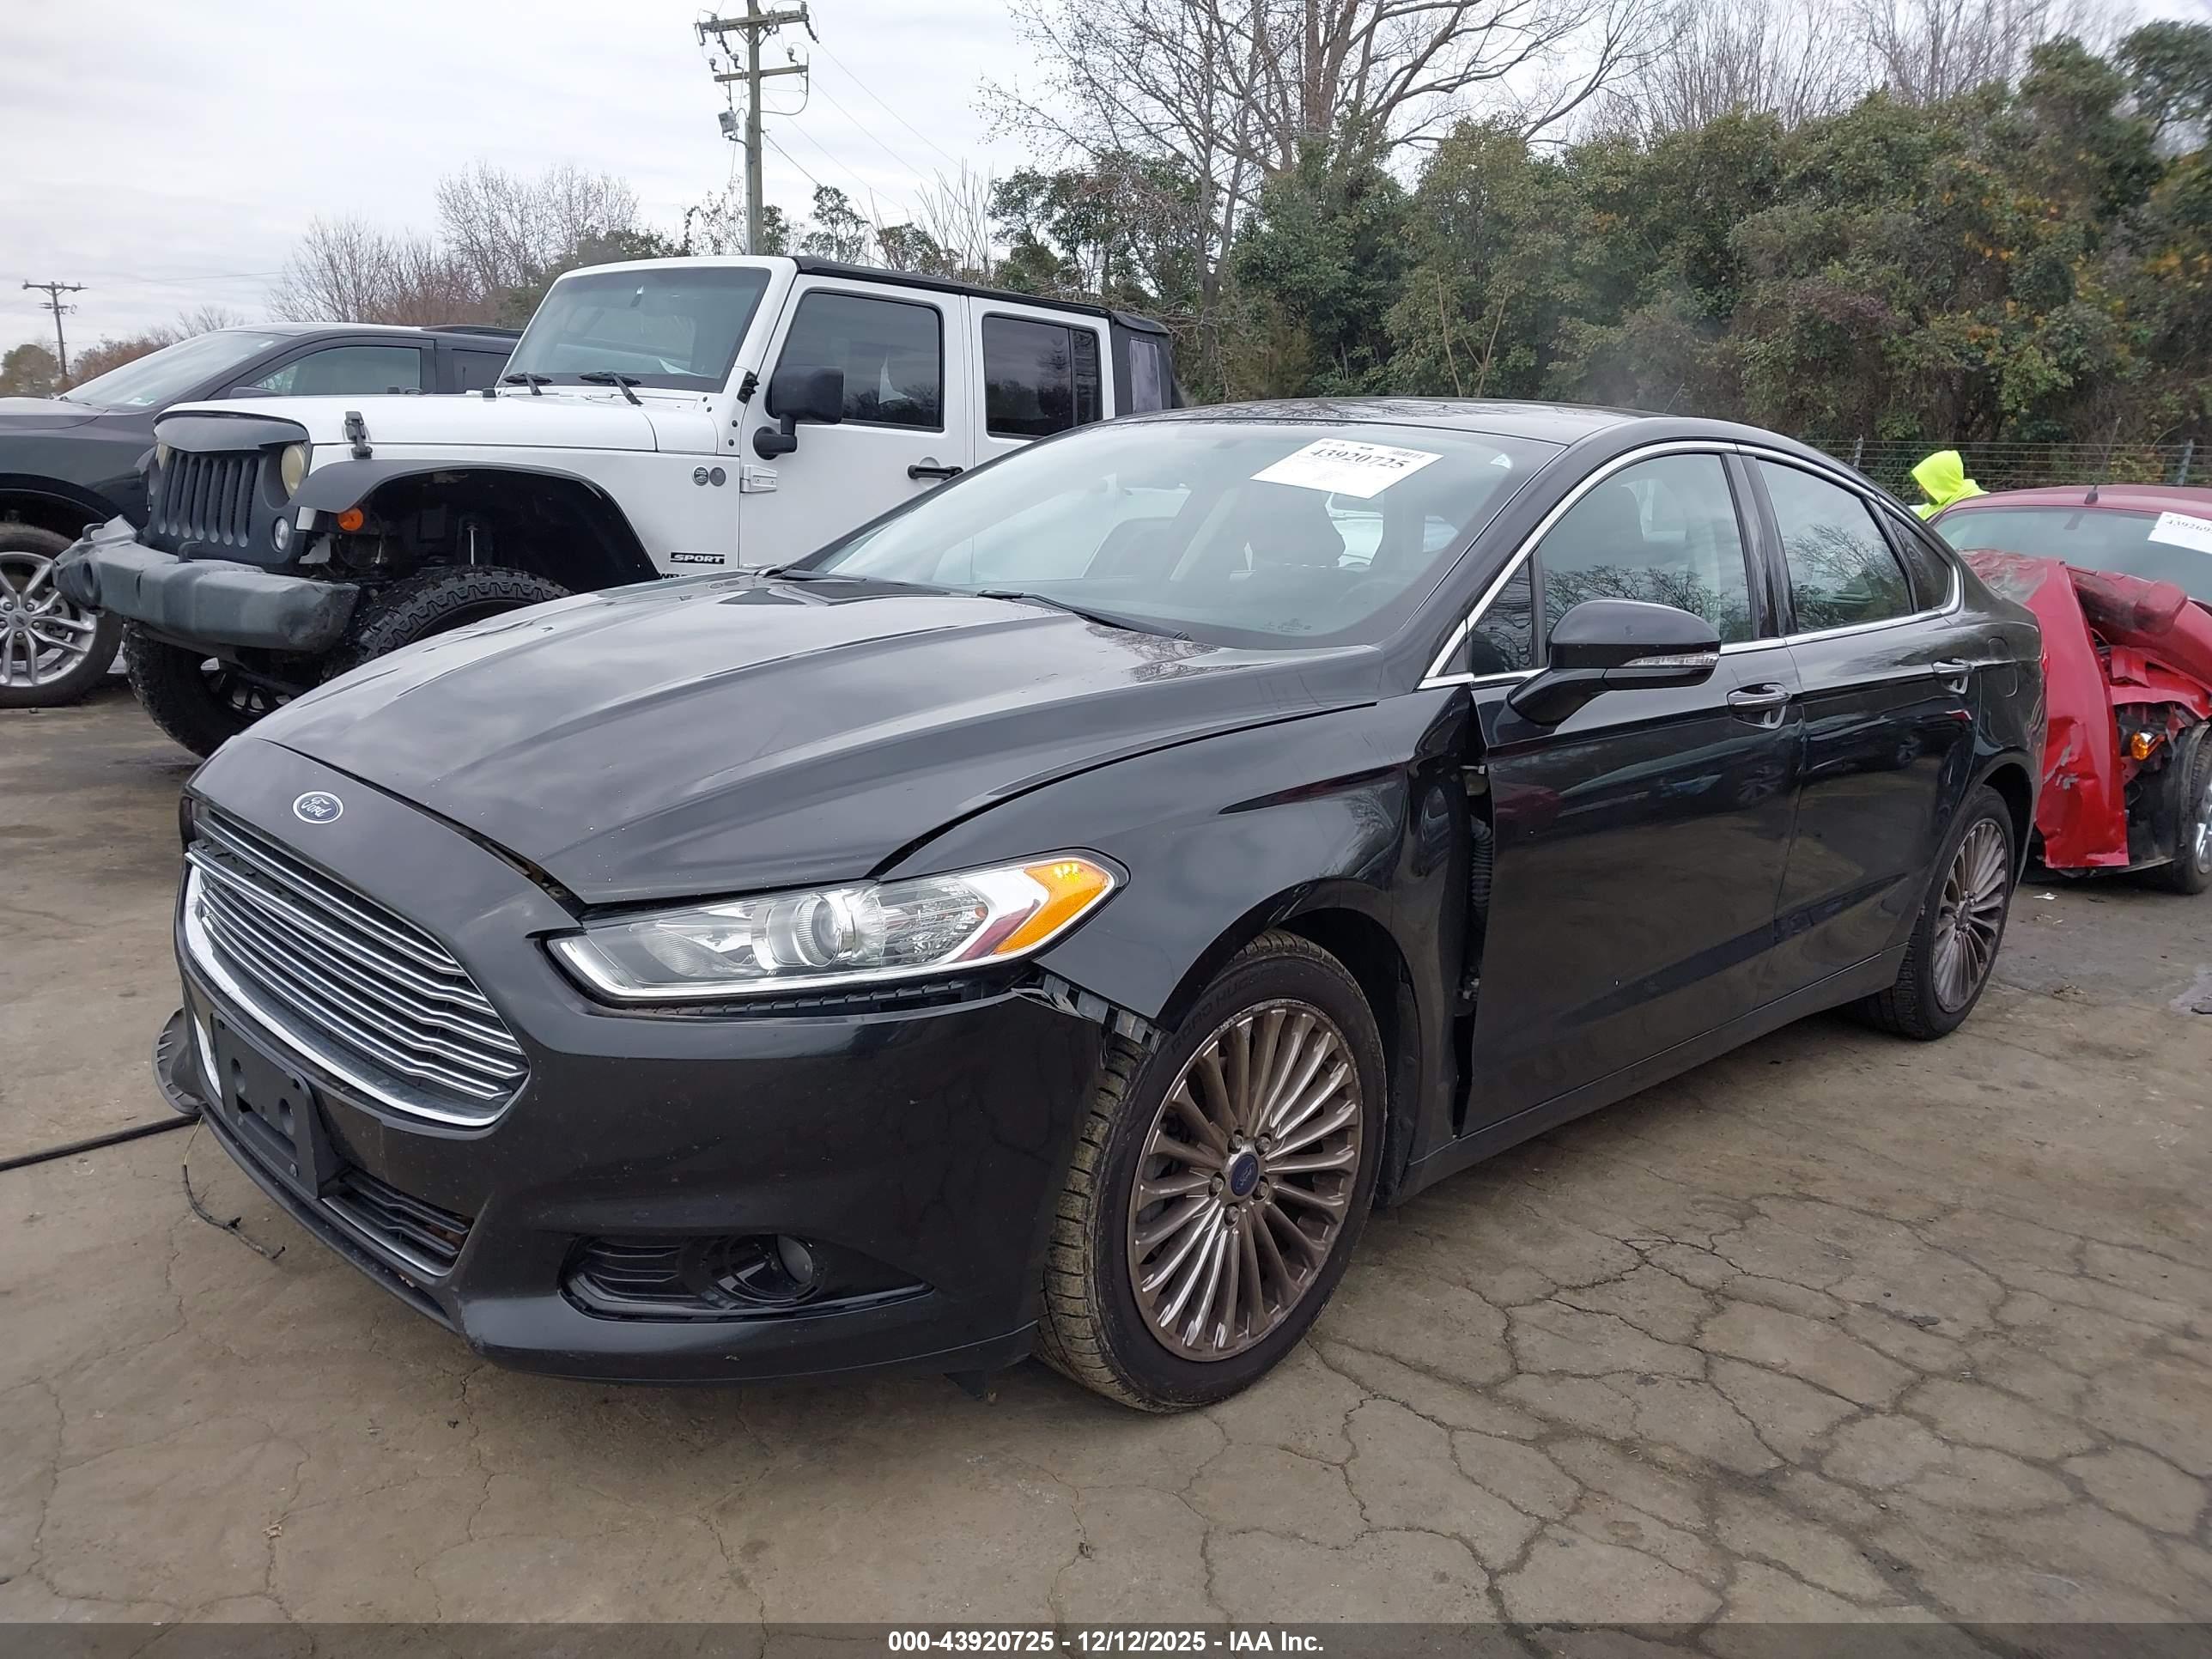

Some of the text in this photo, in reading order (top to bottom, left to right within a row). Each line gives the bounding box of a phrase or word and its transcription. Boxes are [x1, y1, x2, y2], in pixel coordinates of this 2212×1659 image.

[1310, 448, 1411, 469] 43920725
[673, 554, 724, 563] SPORT
[301, 796, 332, 817] Ford
